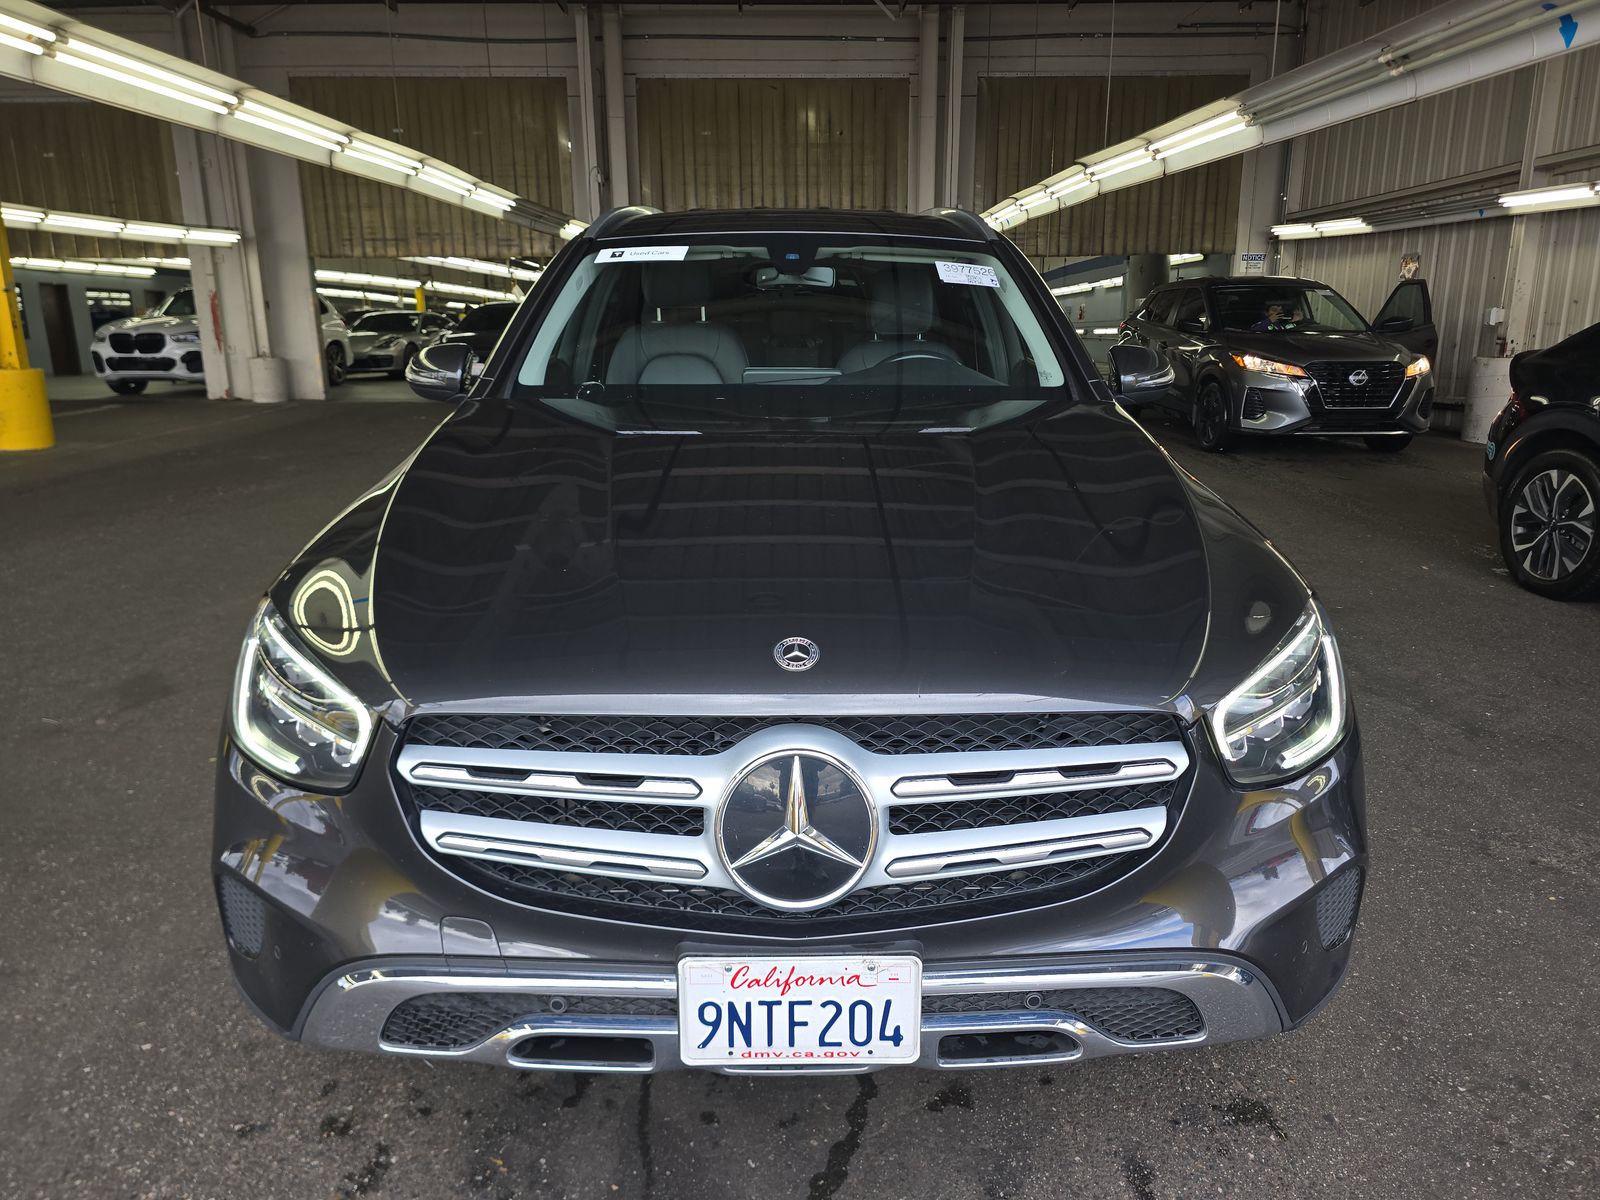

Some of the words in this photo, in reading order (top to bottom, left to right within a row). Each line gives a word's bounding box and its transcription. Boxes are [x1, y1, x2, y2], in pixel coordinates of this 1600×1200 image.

[730, 965, 877, 996] California
[697, 999, 903, 1049] 9NTF204
[741, 1050, 861, 1058] dmv.ca.gov
